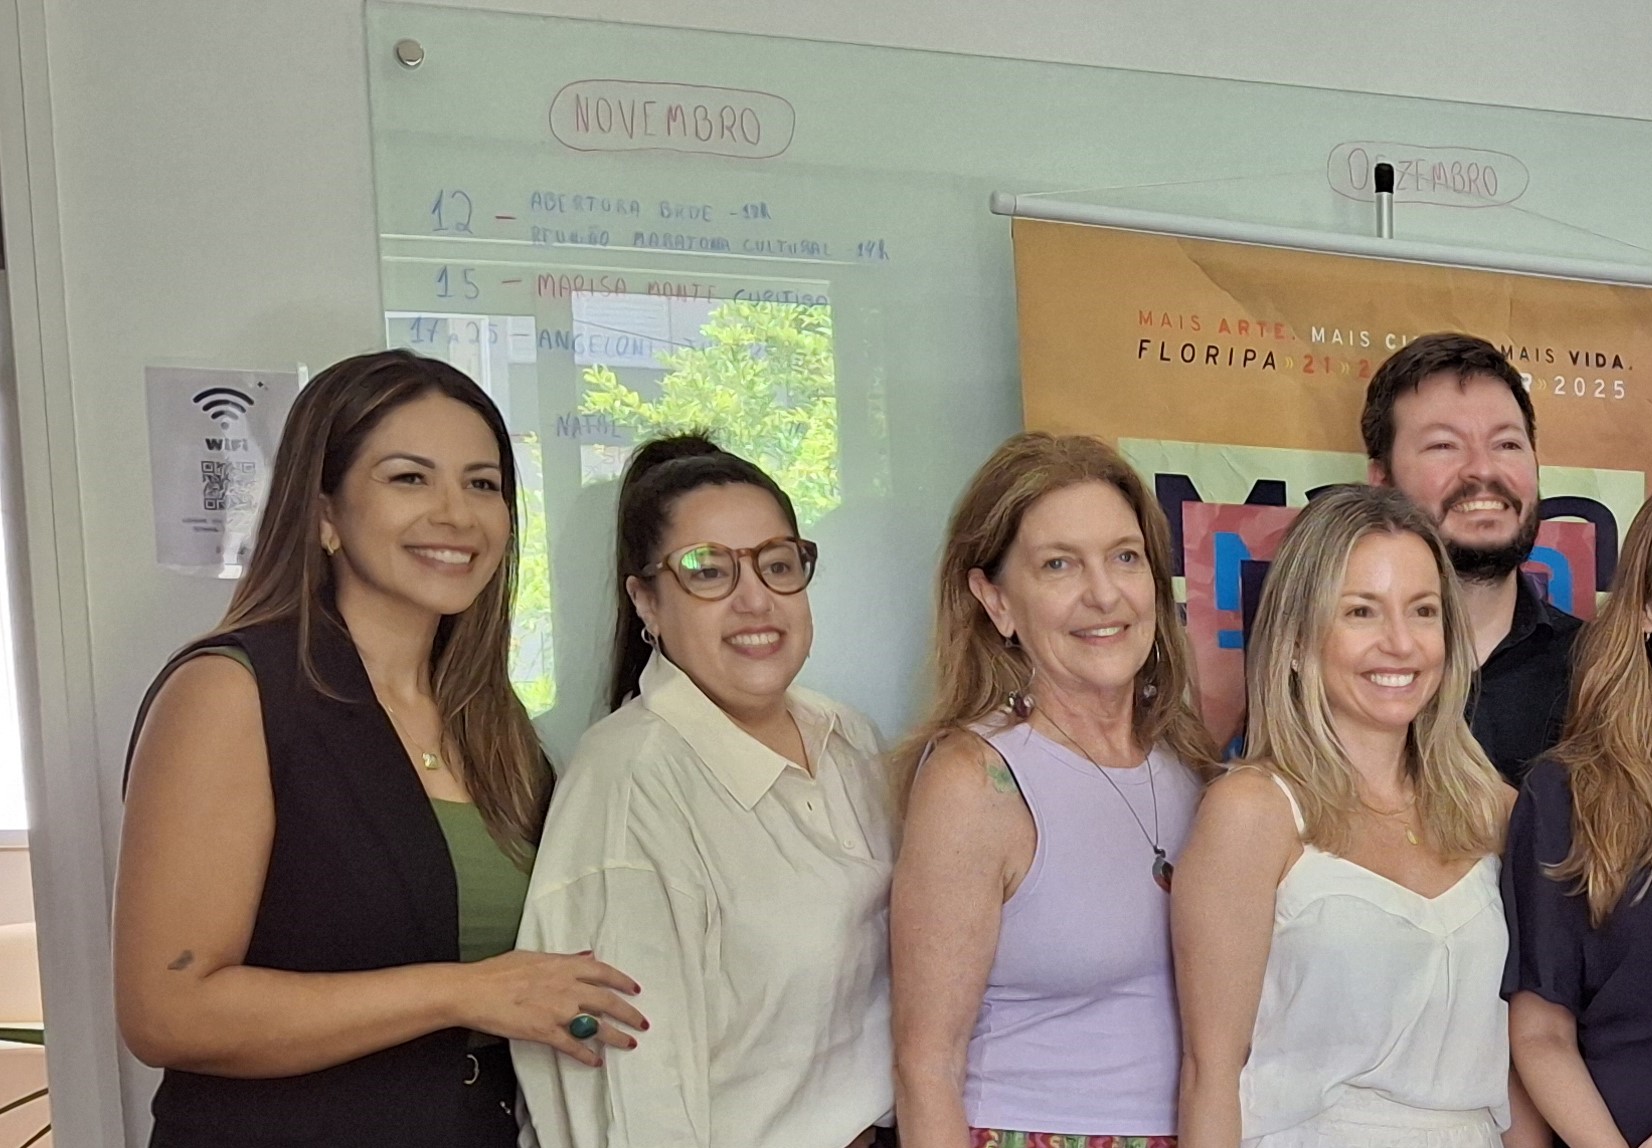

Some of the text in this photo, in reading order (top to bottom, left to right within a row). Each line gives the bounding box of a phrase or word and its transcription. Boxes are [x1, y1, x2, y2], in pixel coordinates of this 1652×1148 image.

[575, 93, 761, 146] NOVEMBRO
[1347, 147, 1498, 197] DZEMBRO
[431, 188, 474, 235] 12
[530, 190, 641, 218] ABERTURA
[633, 229, 731, 252] MARATONA
[742, 238, 832, 257] CULTURAL
[435, 265, 480, 301] 15
[537, 272, 628, 300] MARISA
[646, 280, 718, 304] MONTE
[409, 314, 440, 345] 17
[1138, 309, 1202, 333] MAIS
[1217, 317, 1297, 341] ARTE.
[1310, 324, 1371, 348] MAIS
[1500, 343, 1556, 365] MAIS
[1568, 349, 1634, 372] VIDA.
[1137, 338, 1277, 372] FLORIPA
[1302, 353, 1332, 375] 21
[1553, 374, 1626, 401] 2025
[555, 413, 623, 440] NATAL
